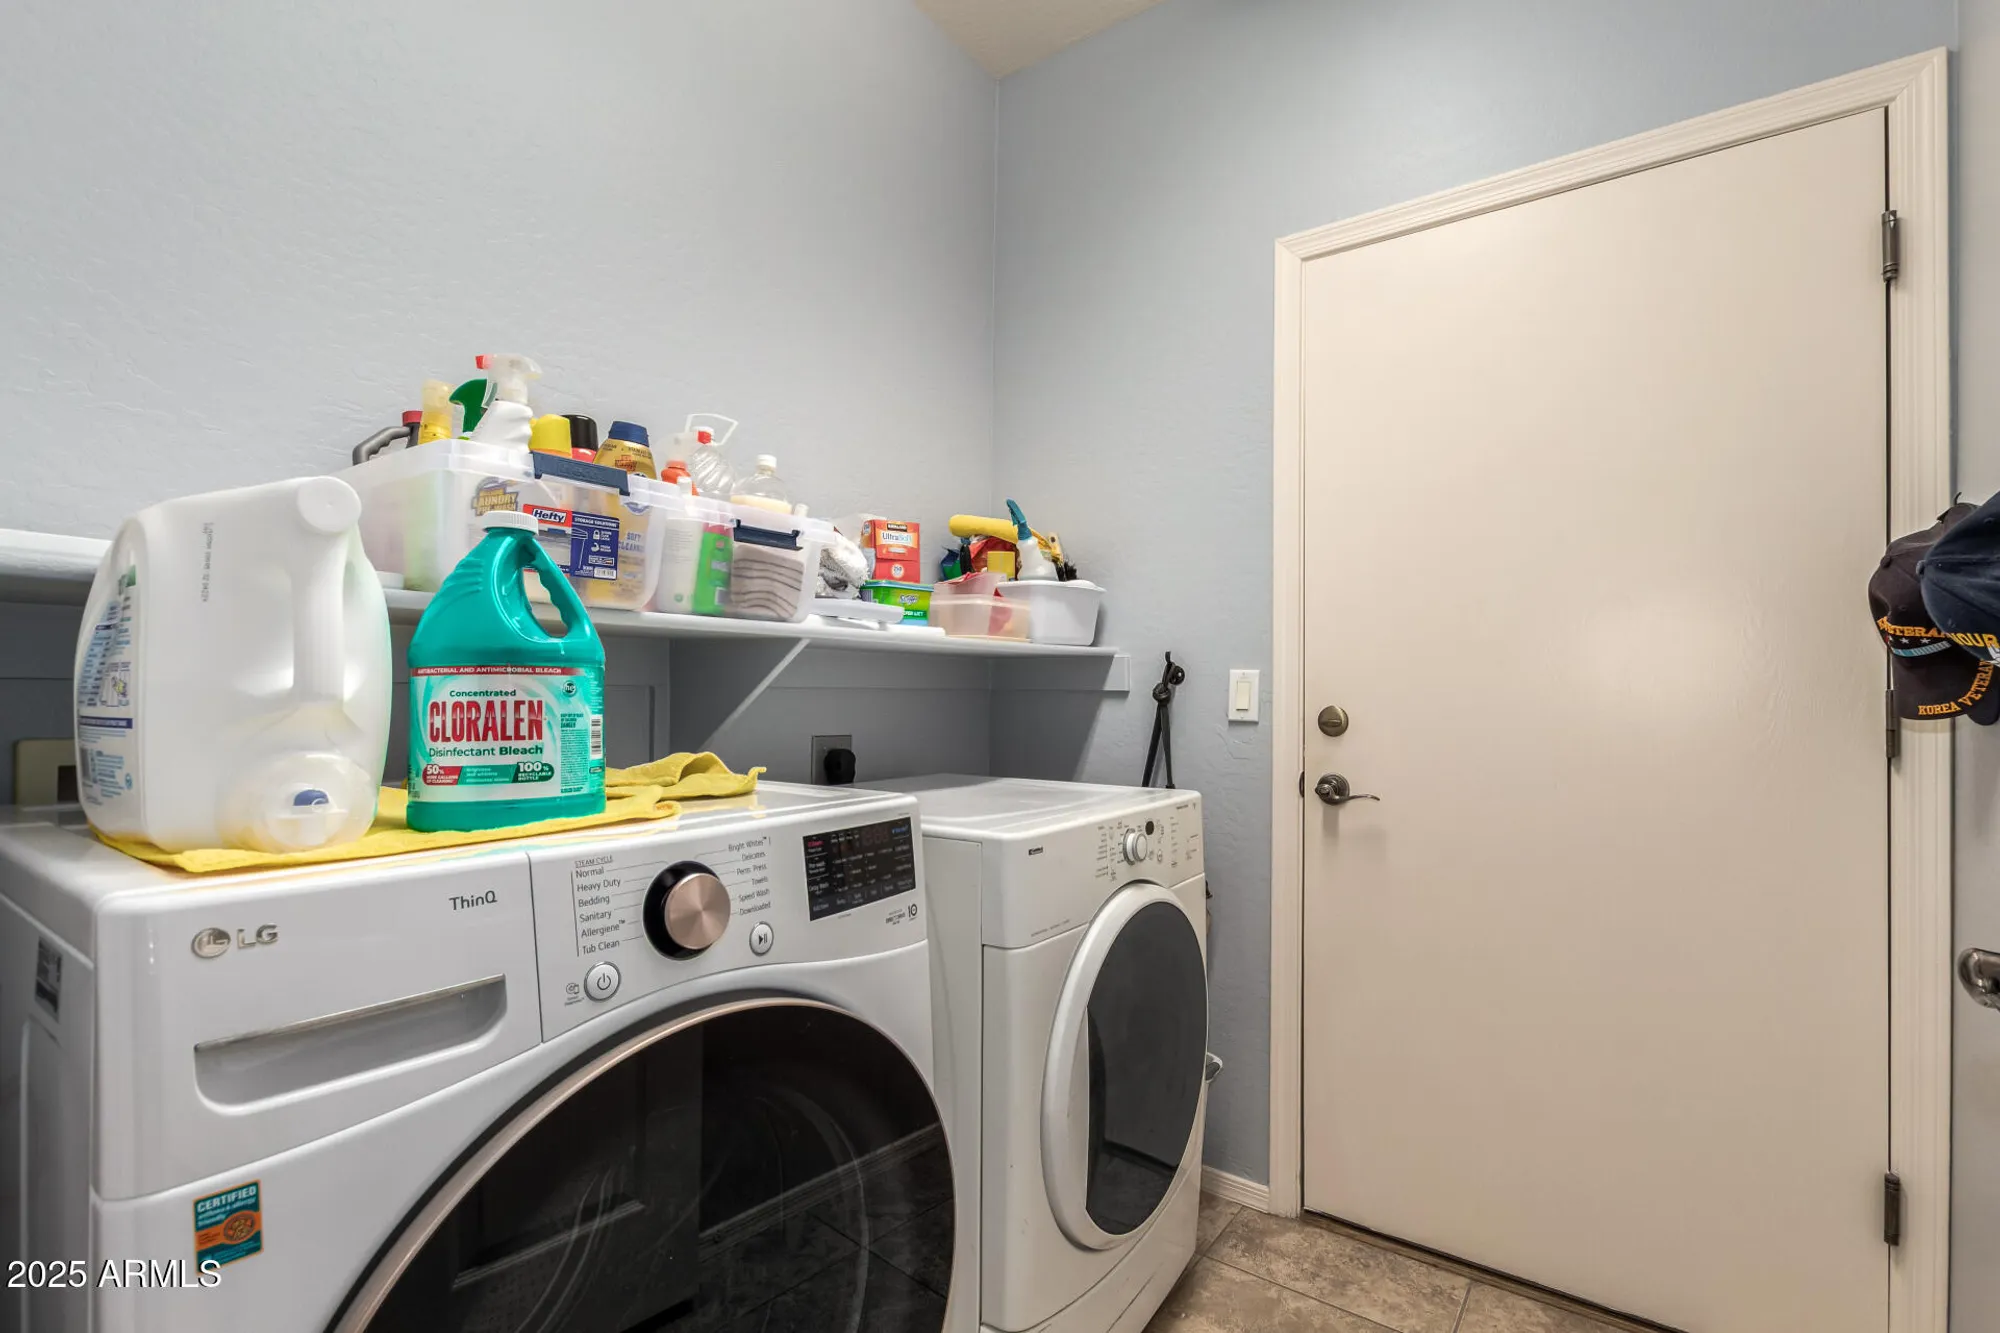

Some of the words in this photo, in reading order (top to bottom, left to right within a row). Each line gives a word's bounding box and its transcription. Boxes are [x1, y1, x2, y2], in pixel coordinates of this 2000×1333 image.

[534, 509, 565, 523] Hefty
[449, 689, 517, 697] Concentrated
[1918, 701, 1962, 715] KOREA
[429, 700, 543, 743] CLORALEN
[429, 747, 495, 757] Disinfectant
[499, 745, 543, 756] Bleach
[576, 867, 604, 878] Normal
[576, 882, 601, 892] Heavy
[603, 879, 621, 888] Duty
[755, 888, 770, 897] Wash
[449, 890, 498, 911] ThinQ
[578, 895, 610, 907] Bedding
[739, 901, 771, 915] Downloaded
[579, 911, 612, 922] Sanitary
[237, 923, 279, 949] LG
[582, 945, 596, 955] Tub
[598, 940, 620, 951] Clean
[197, 1185, 257, 1213] CERTIFIED
